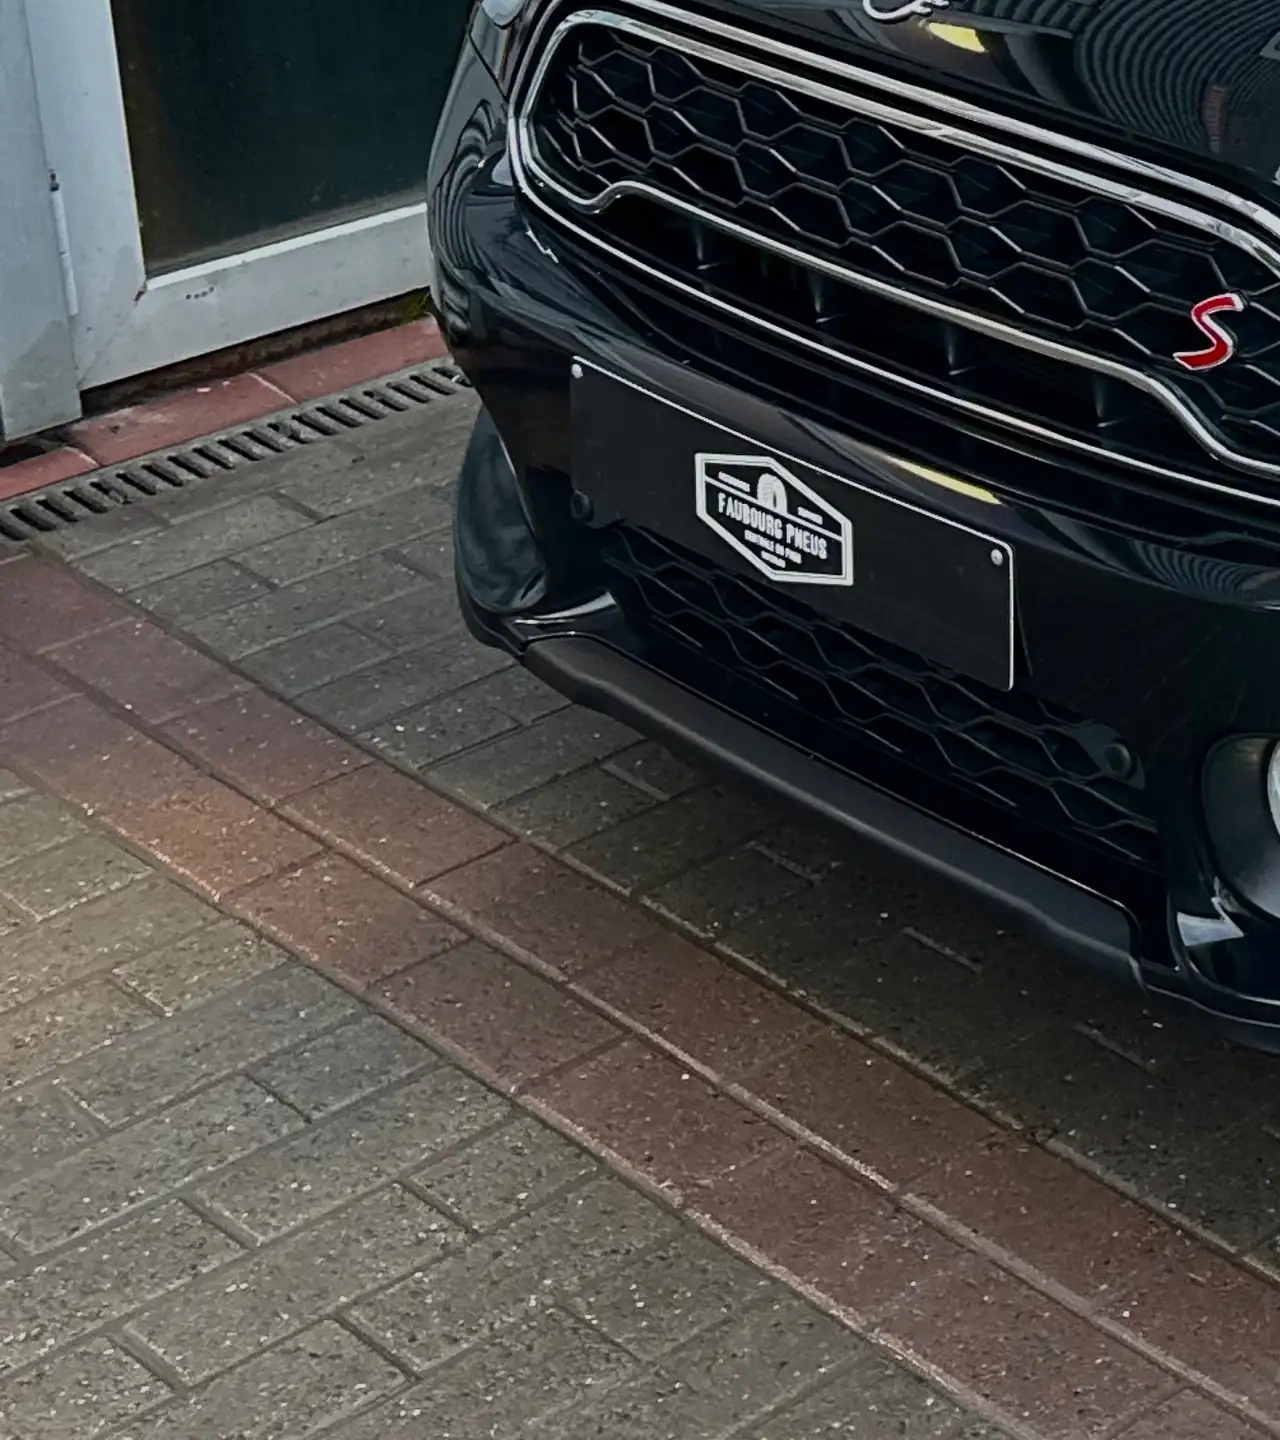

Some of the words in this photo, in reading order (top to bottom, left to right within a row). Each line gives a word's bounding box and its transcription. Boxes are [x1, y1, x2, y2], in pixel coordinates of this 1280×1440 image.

[1172, 292, 1245, 372] S
[718, 492, 783, 540] FAUBOURG
[786, 523, 828, 559] PNEUS
